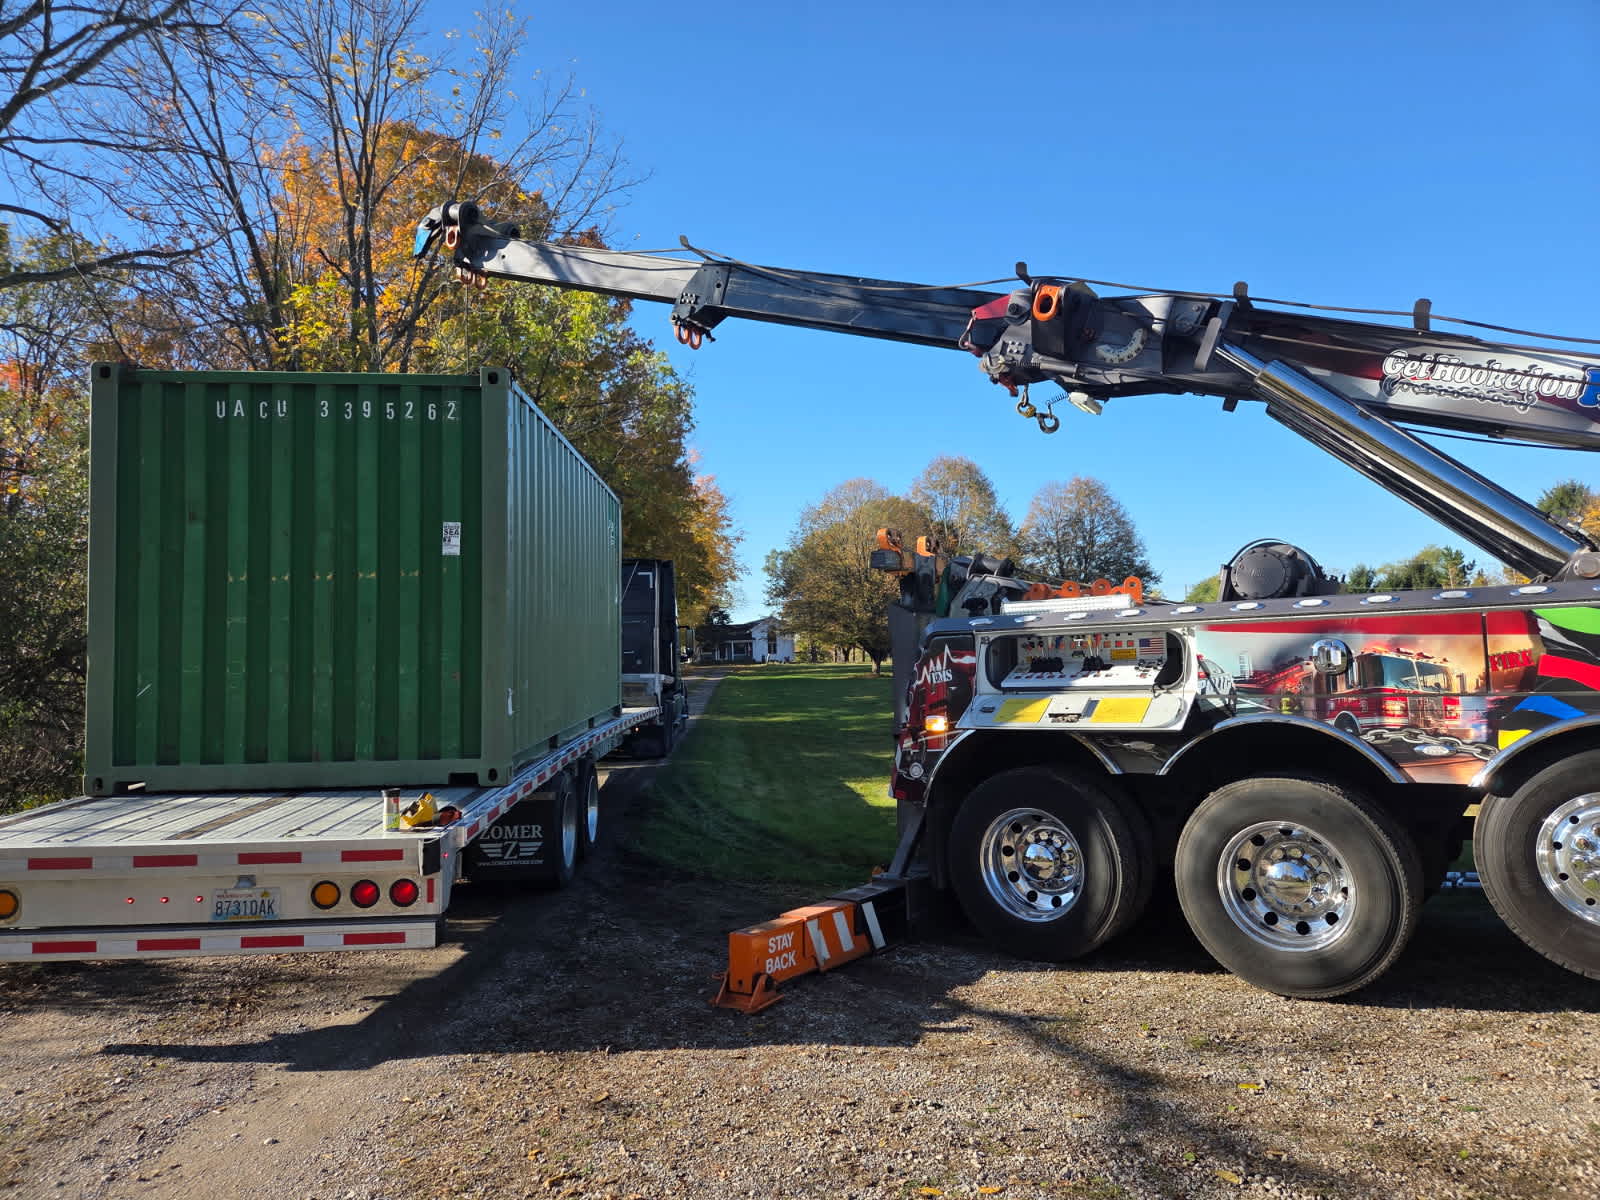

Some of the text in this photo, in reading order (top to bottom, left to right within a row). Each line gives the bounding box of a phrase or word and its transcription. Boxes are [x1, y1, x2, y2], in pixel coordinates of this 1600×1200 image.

[216, 400, 457, 420] UACU 3395262
[1489, 649, 1535, 671] FIRE
[479, 824, 544, 840] ZOMER
[768, 931, 794, 954] STAY
[765, 950, 797, 975] BACK
